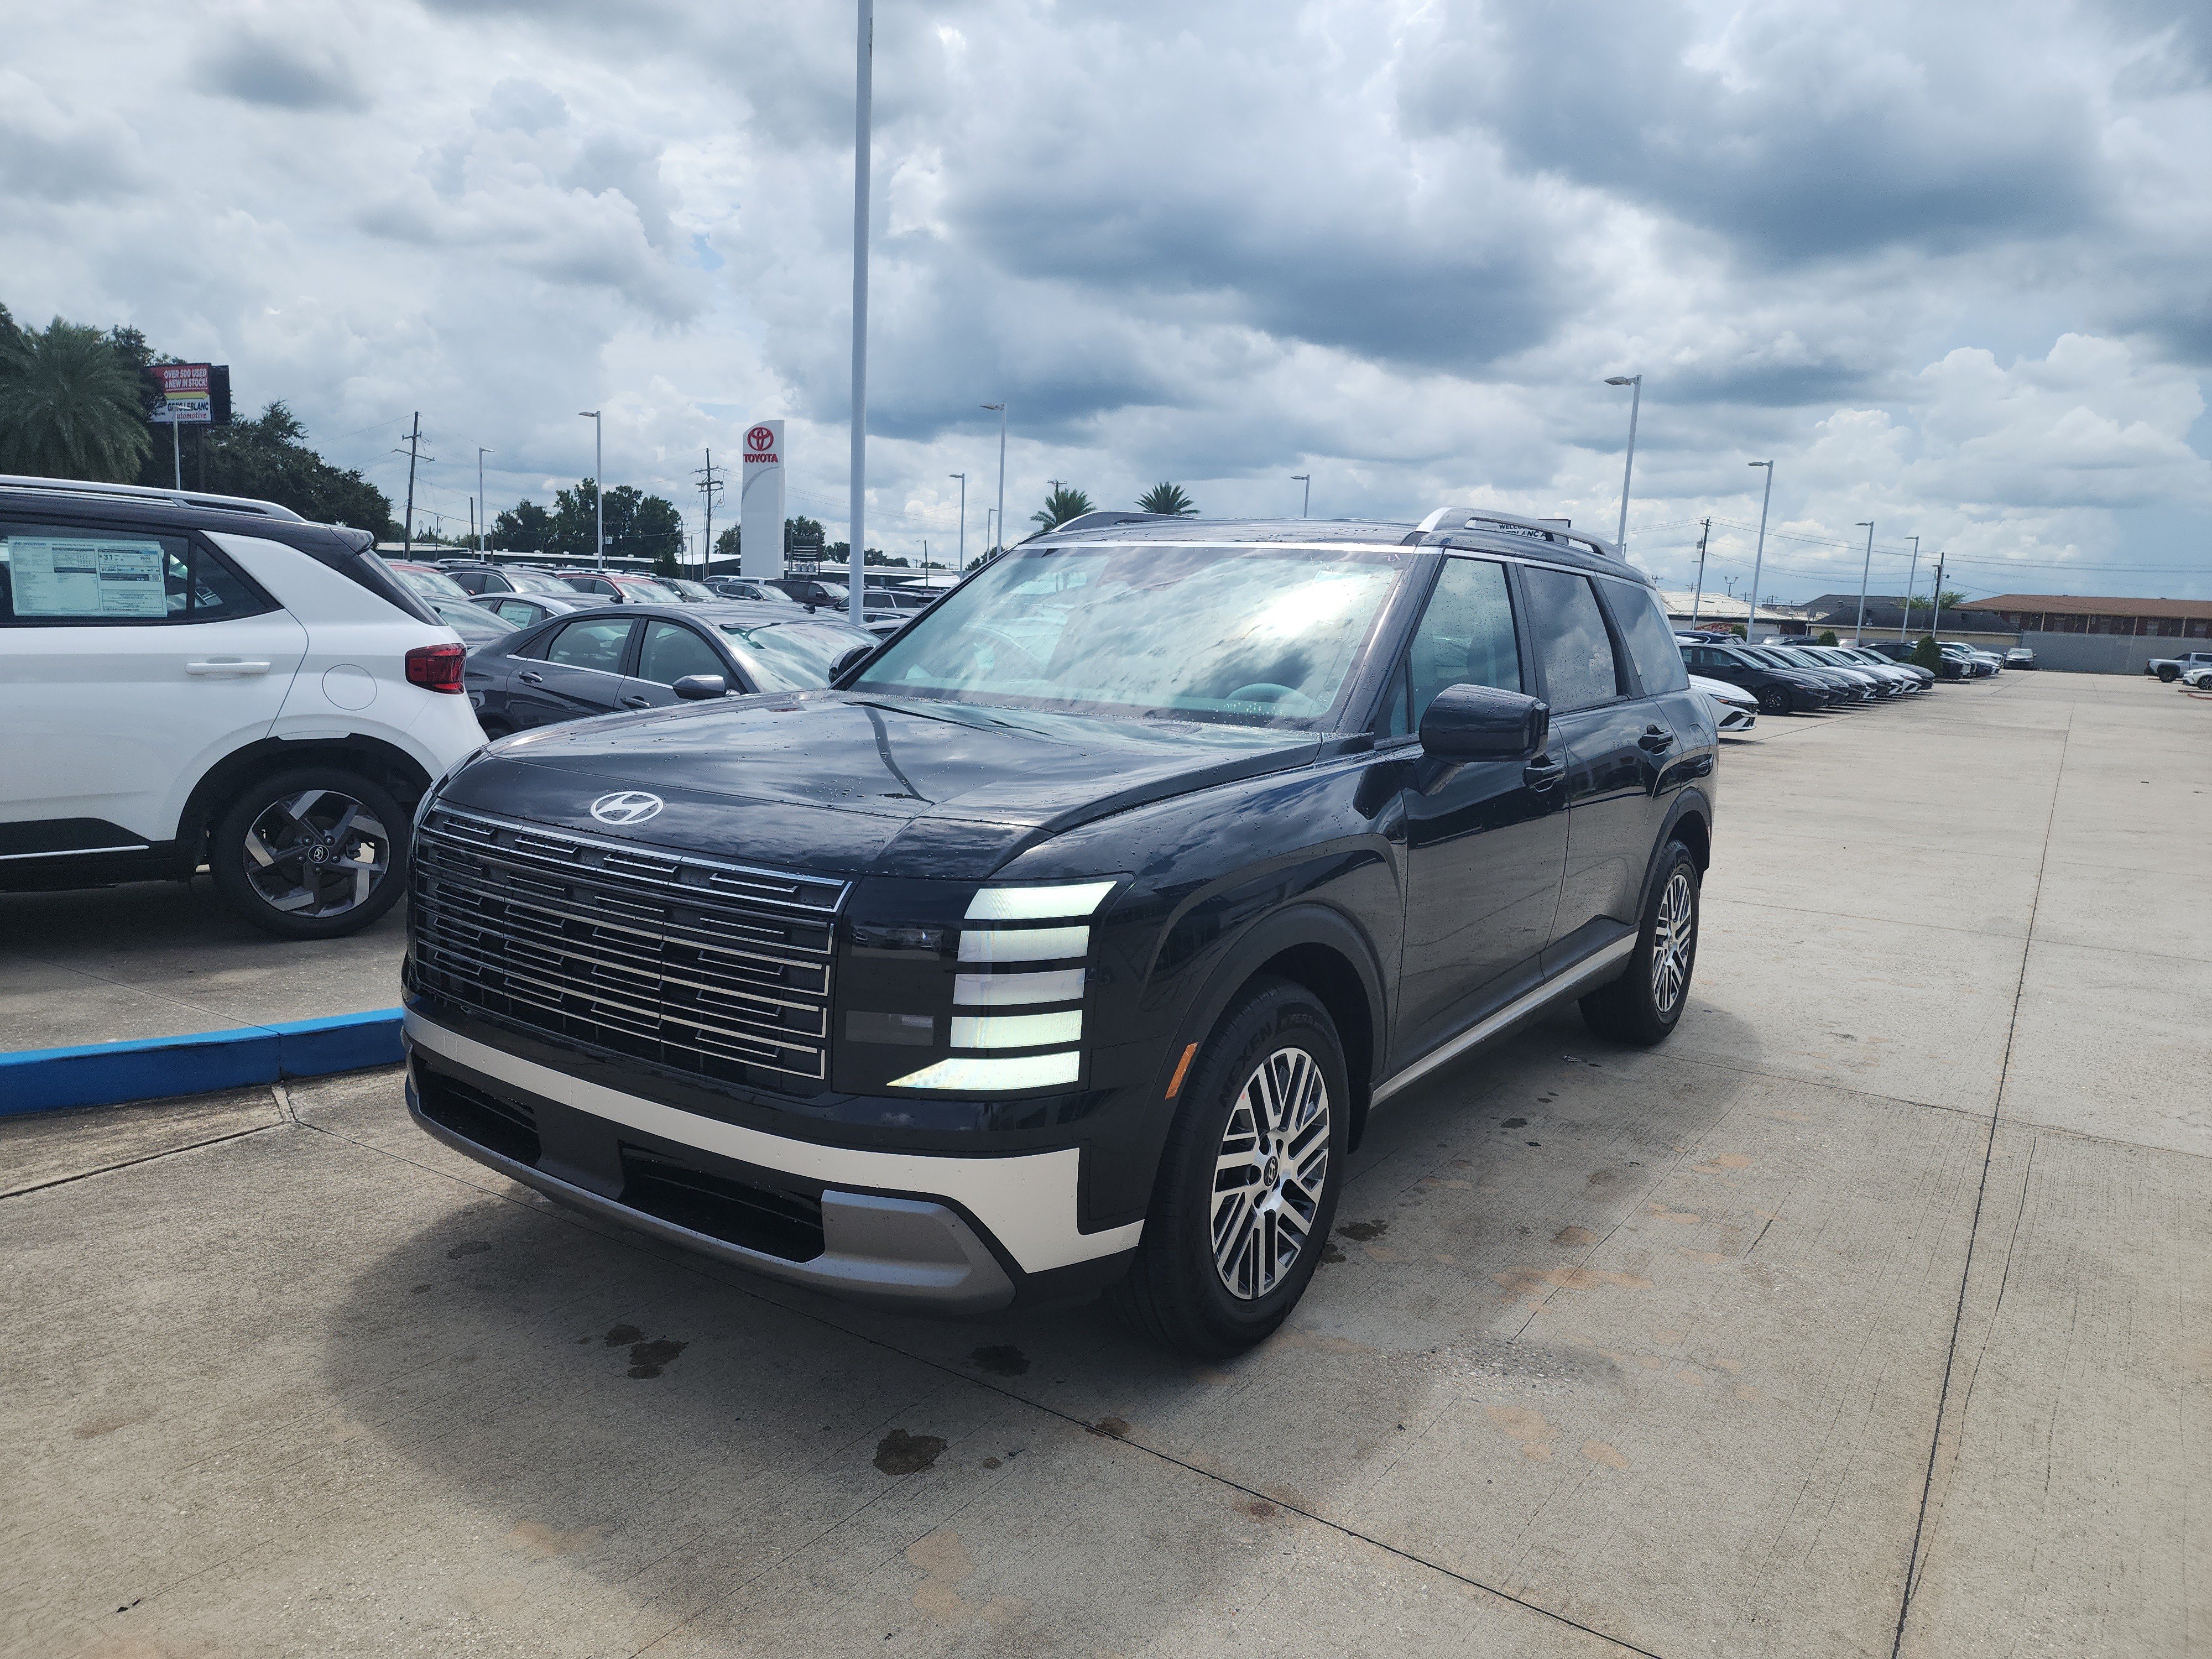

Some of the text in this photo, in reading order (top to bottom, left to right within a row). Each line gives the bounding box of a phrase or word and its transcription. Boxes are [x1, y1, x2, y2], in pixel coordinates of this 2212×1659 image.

[164, 368, 207, 379] OVER 500 USED
[169, 379, 181, 388] NEW
[182, 378, 187, 388] IN
[189, 378, 207, 388] STOCK!
[176, 411, 207, 419] utomotive
[743, 453, 778, 463] TOYOTA
[1218, 1022, 1272, 1108] NEXEN
